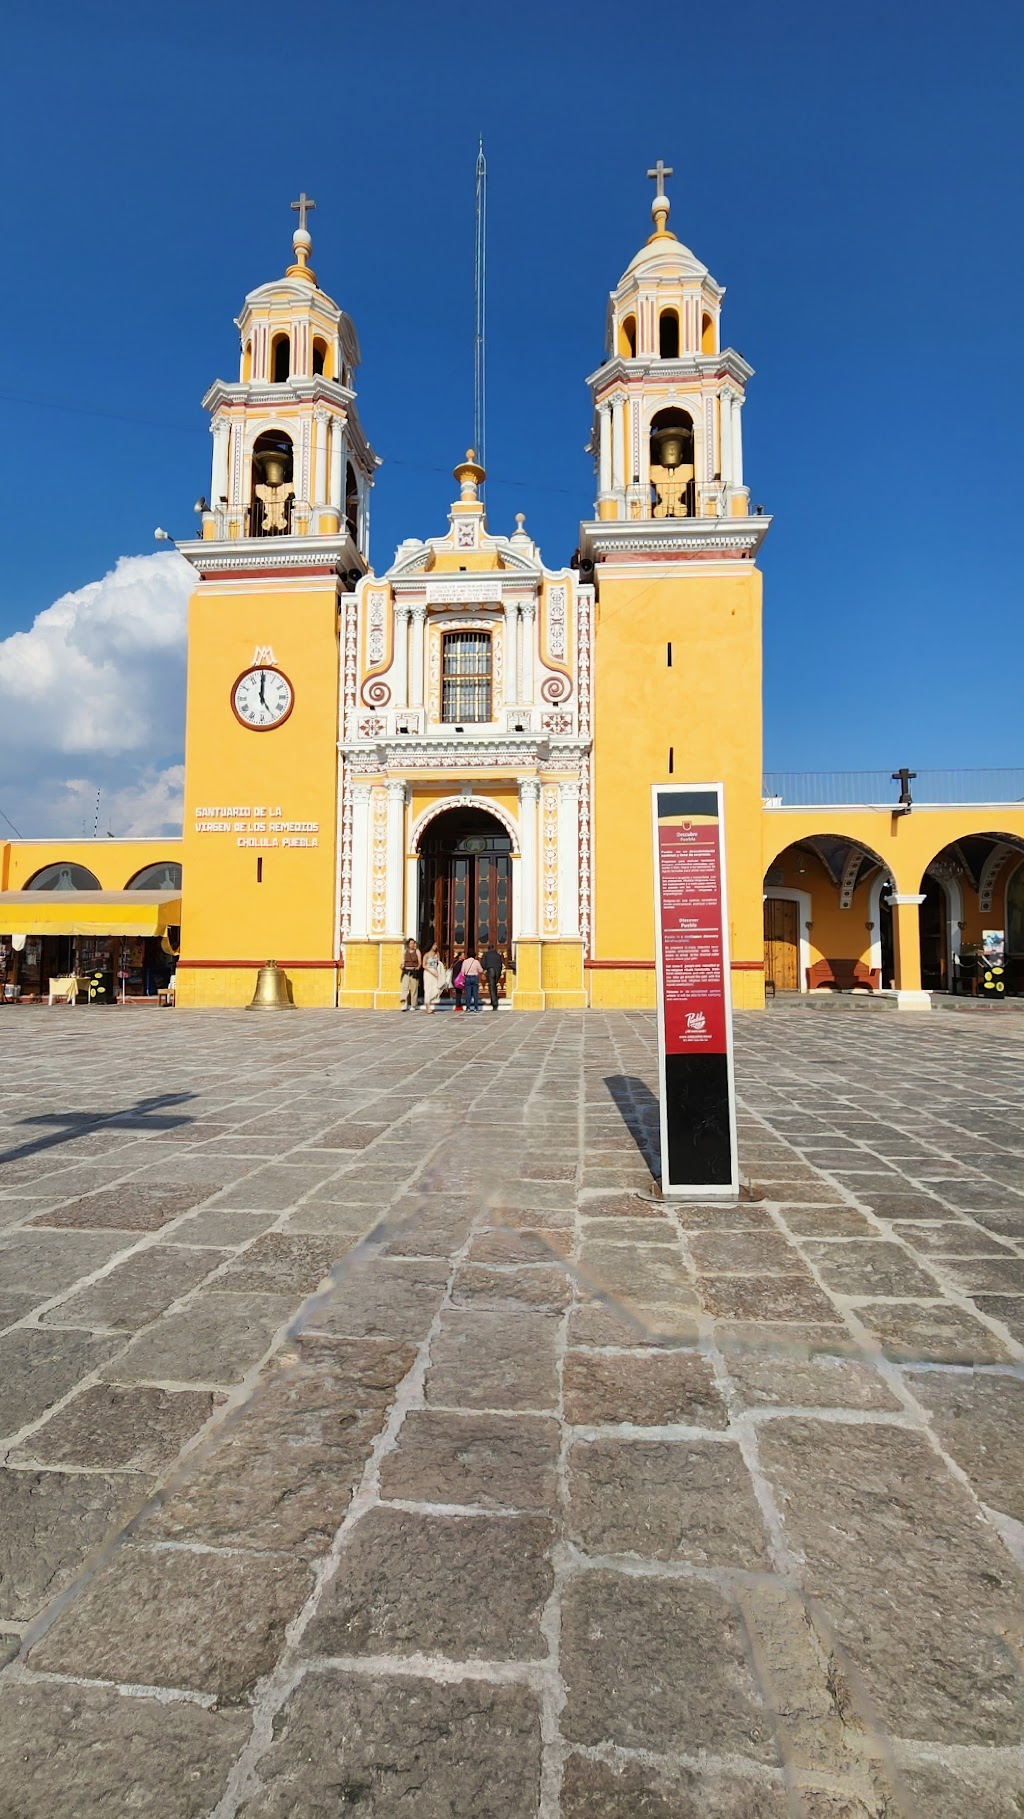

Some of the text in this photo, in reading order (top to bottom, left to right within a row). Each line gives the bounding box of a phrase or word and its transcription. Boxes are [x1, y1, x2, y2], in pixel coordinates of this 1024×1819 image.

[195, 807, 282, 818] SANTUARIO DE LA
[195, 822, 319, 832] VIRGEN DE LOS REMEDIOS
[237, 837, 319, 848] CHOLULA PUEBLA
